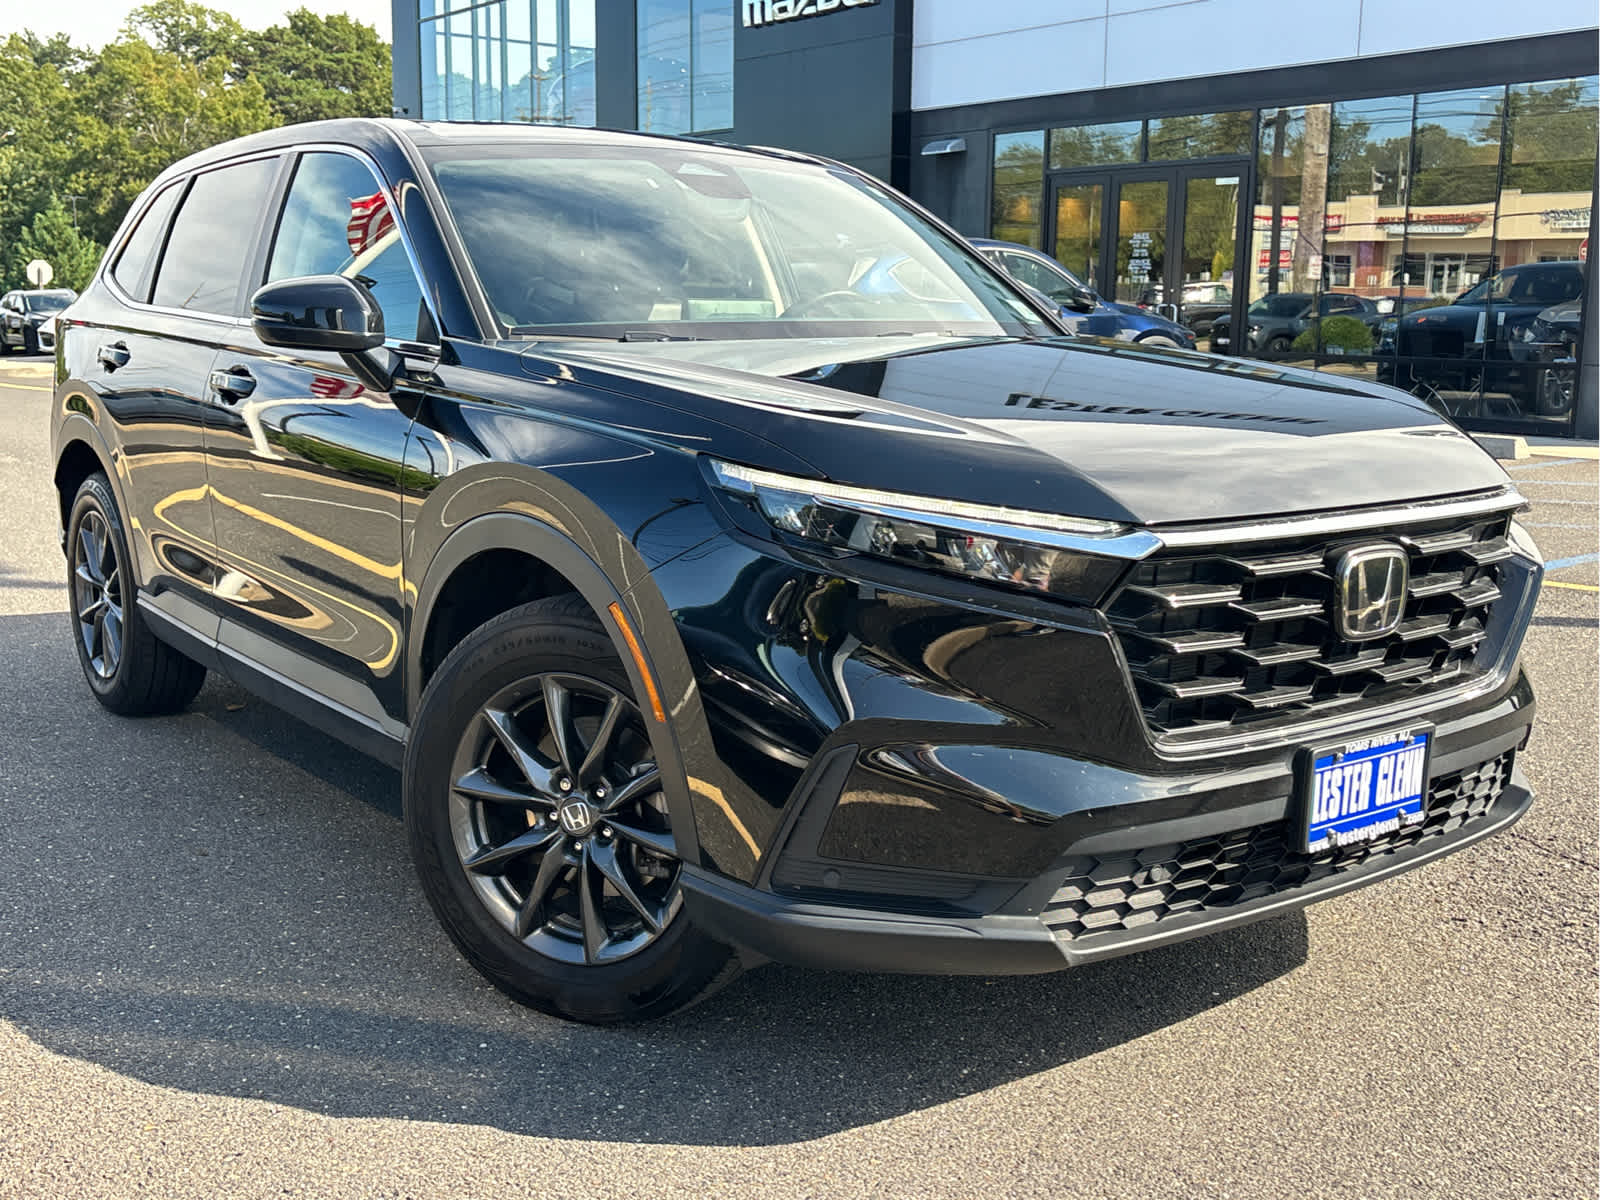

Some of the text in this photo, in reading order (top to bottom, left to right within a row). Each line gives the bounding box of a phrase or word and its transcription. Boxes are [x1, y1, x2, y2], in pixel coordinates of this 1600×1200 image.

[742, 0, 874, 28] maz
[1344, 739, 1370, 754] TOMS
[1312, 746, 1426, 825] LESTER GLENN
